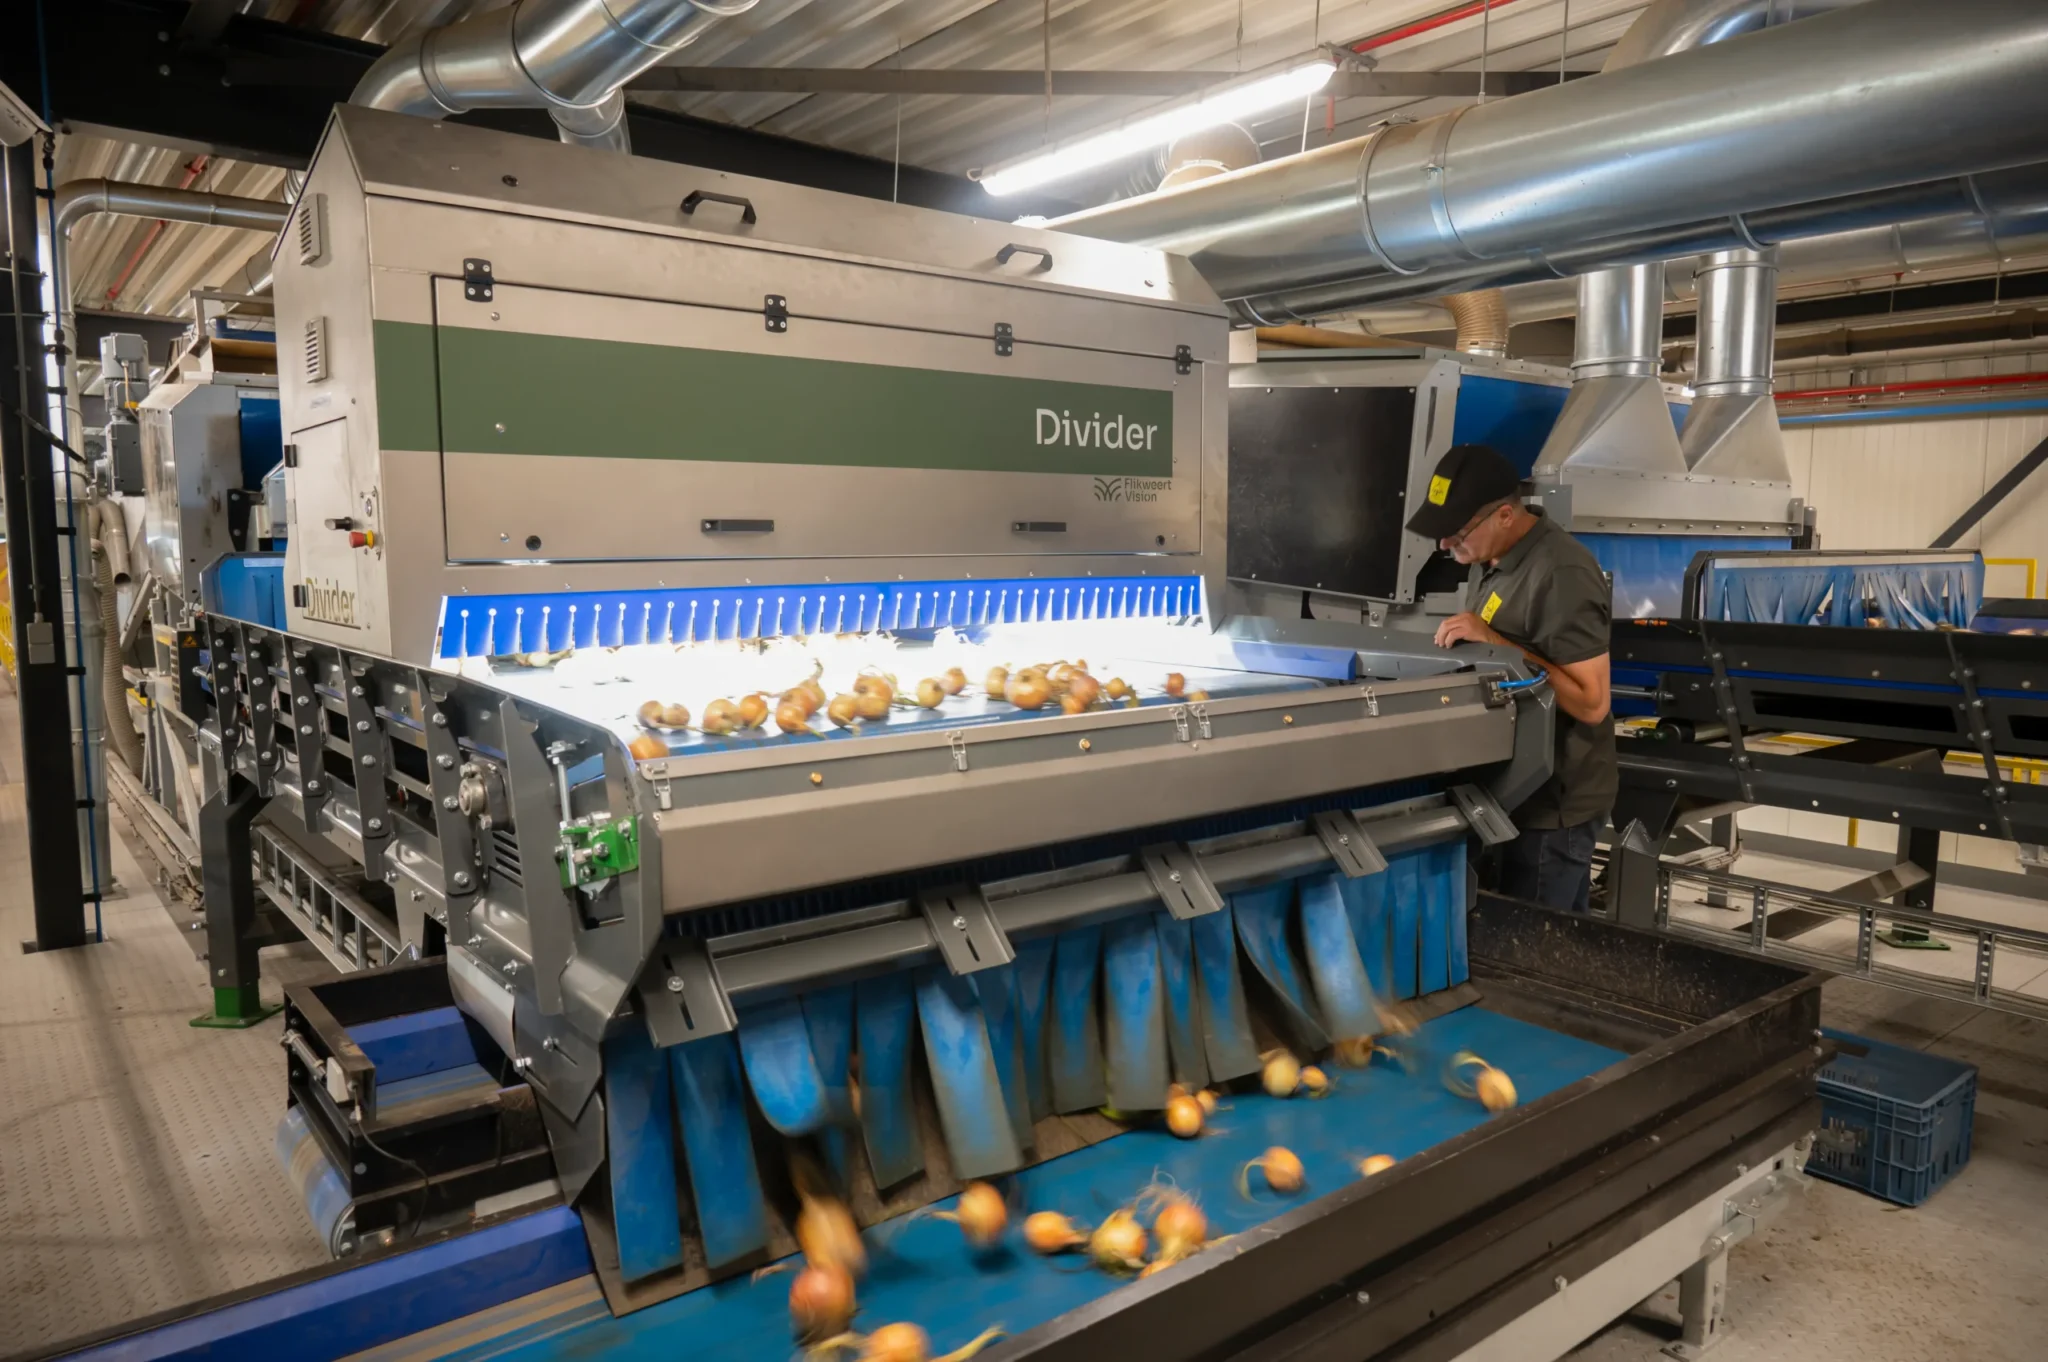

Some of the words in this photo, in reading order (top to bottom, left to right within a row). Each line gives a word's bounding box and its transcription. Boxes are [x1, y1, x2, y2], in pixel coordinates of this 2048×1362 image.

[1036, 408, 1158, 451] Divider
[1124, 477, 1172, 490] Flikweert
[1125, 490, 1158, 502] Vision
[306, 577, 355, 624] Divider
